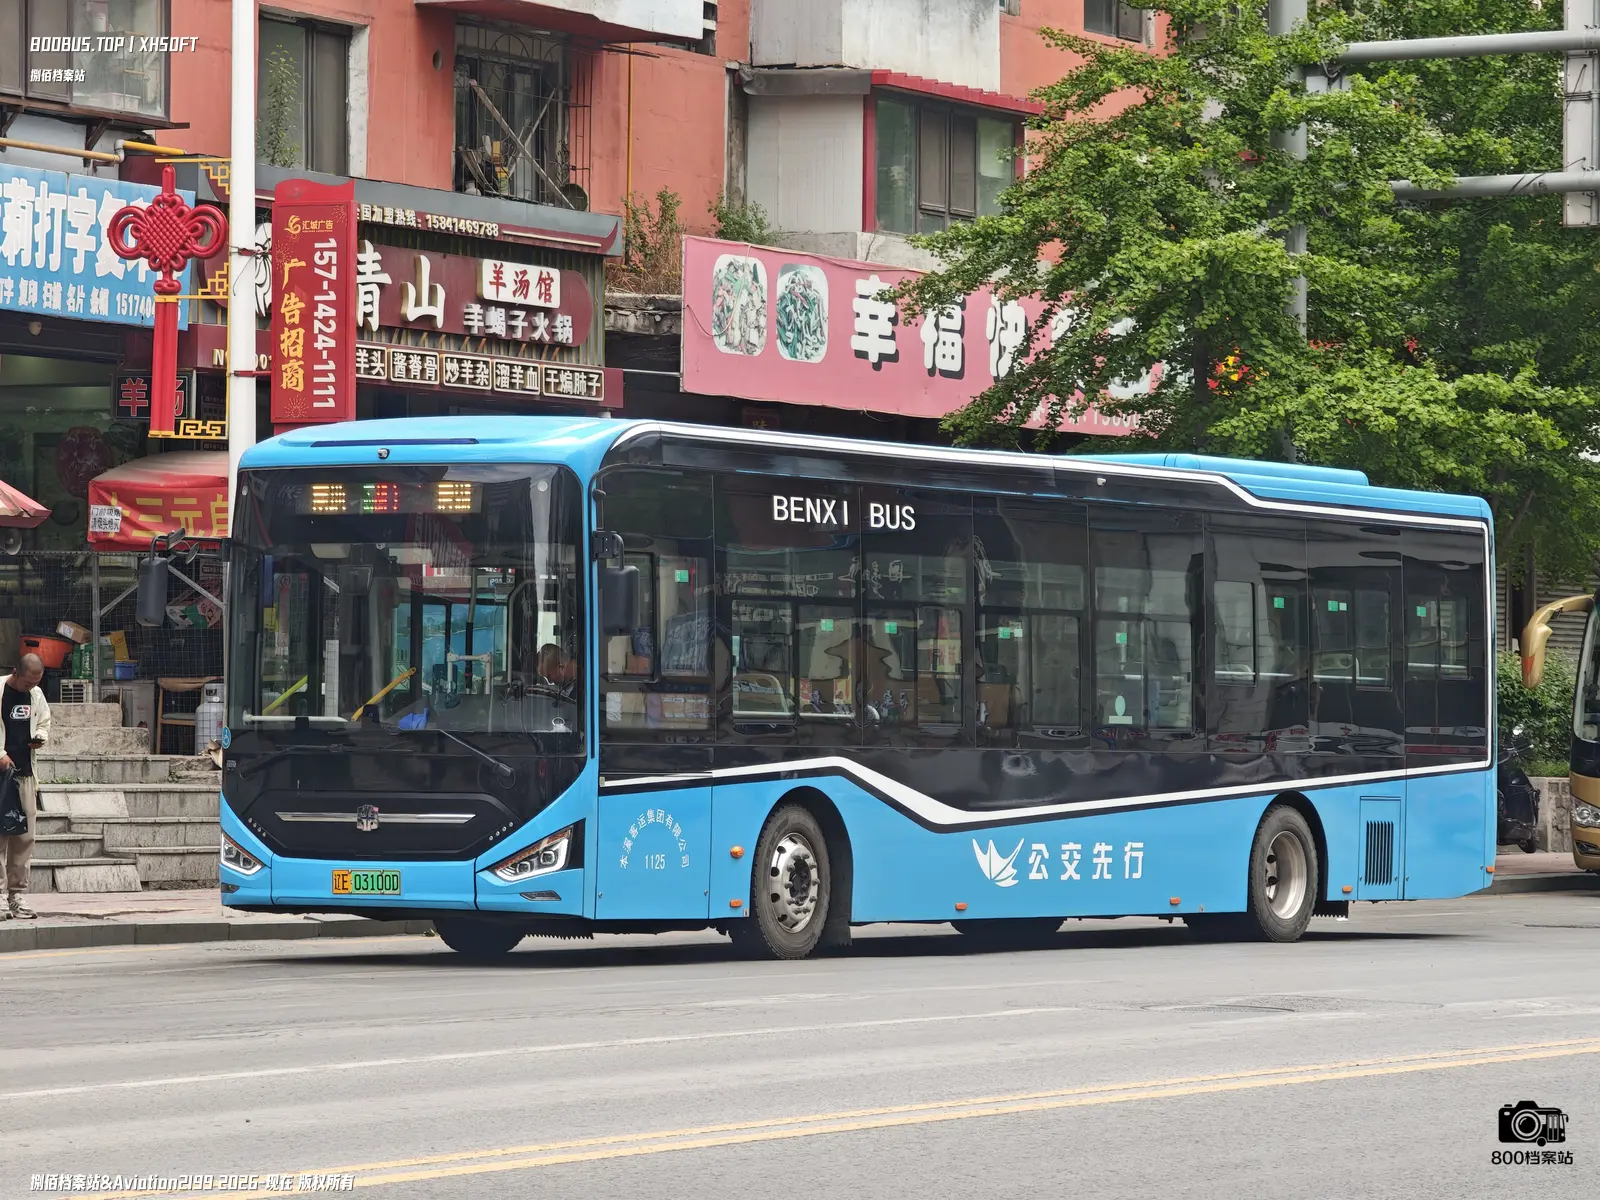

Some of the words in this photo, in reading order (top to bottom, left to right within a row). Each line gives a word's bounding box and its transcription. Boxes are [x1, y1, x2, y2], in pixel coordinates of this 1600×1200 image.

[302, 220, 334, 230] 汇城广告
[356, 203, 421, 228] 国加盟热线:
[426, 214, 499, 237] 15841469788
[489, 262, 555, 304] 羊汤馆
[279, 258, 307, 393] 广告招商
[313, 237, 337, 408] 157-1424-1111
[463, 303, 574, 344] 羊蝎子火锅
[445, 358, 491, 386] 炒羊杂
[773, 495, 849, 526] BENXI
[869, 503, 916, 531] BUS
[620, 809, 690, 870] 本溪客运集团有限公司
[645, 854, 666, 870] 1125
[1029, 841, 1145, 881] 公交先行
